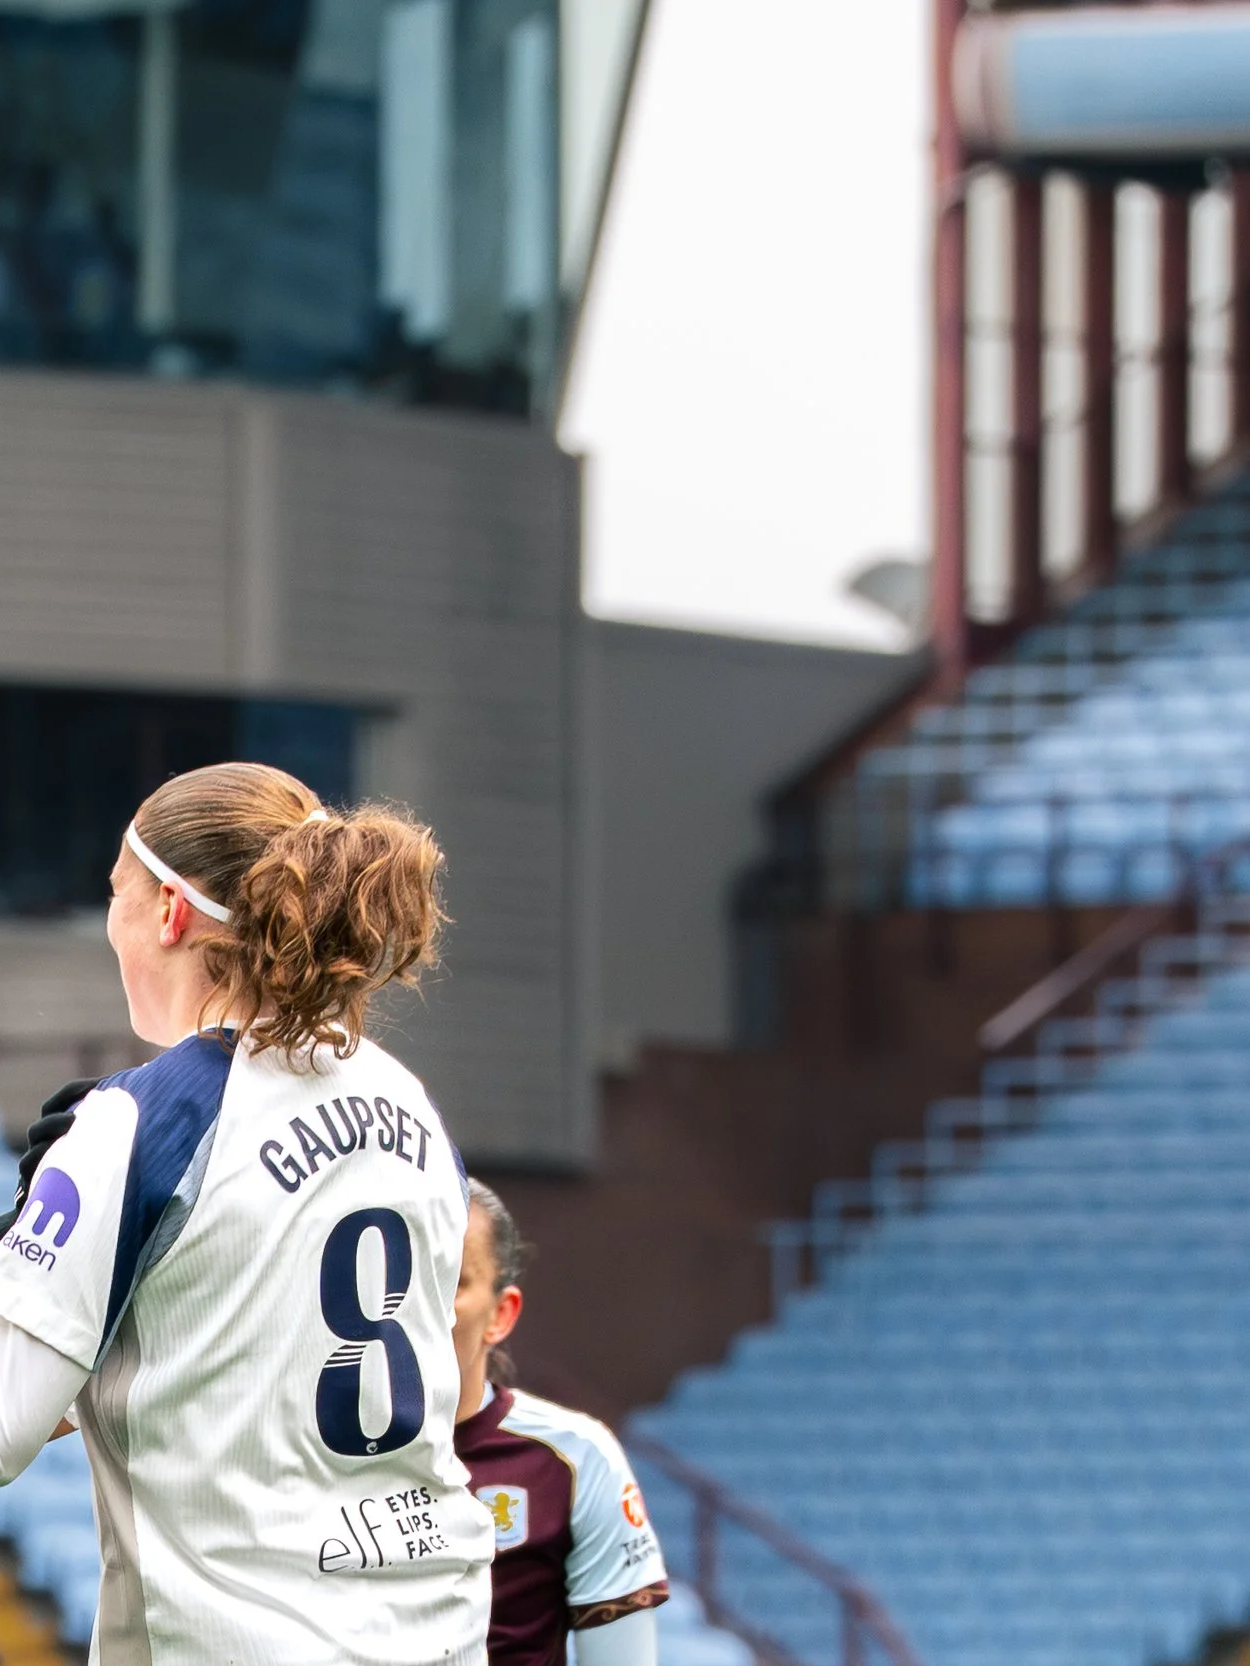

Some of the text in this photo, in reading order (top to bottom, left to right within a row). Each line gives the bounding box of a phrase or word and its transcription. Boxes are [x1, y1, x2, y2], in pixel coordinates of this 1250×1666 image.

[259, 1096, 432, 1194] GAUPSET
[2, 1230, 56, 1272] aken
[315, 1207, 425, 1457] 8
[384, 1486, 438, 1513] EYES.
[396, 1512, 438, 1536] LIPS.
